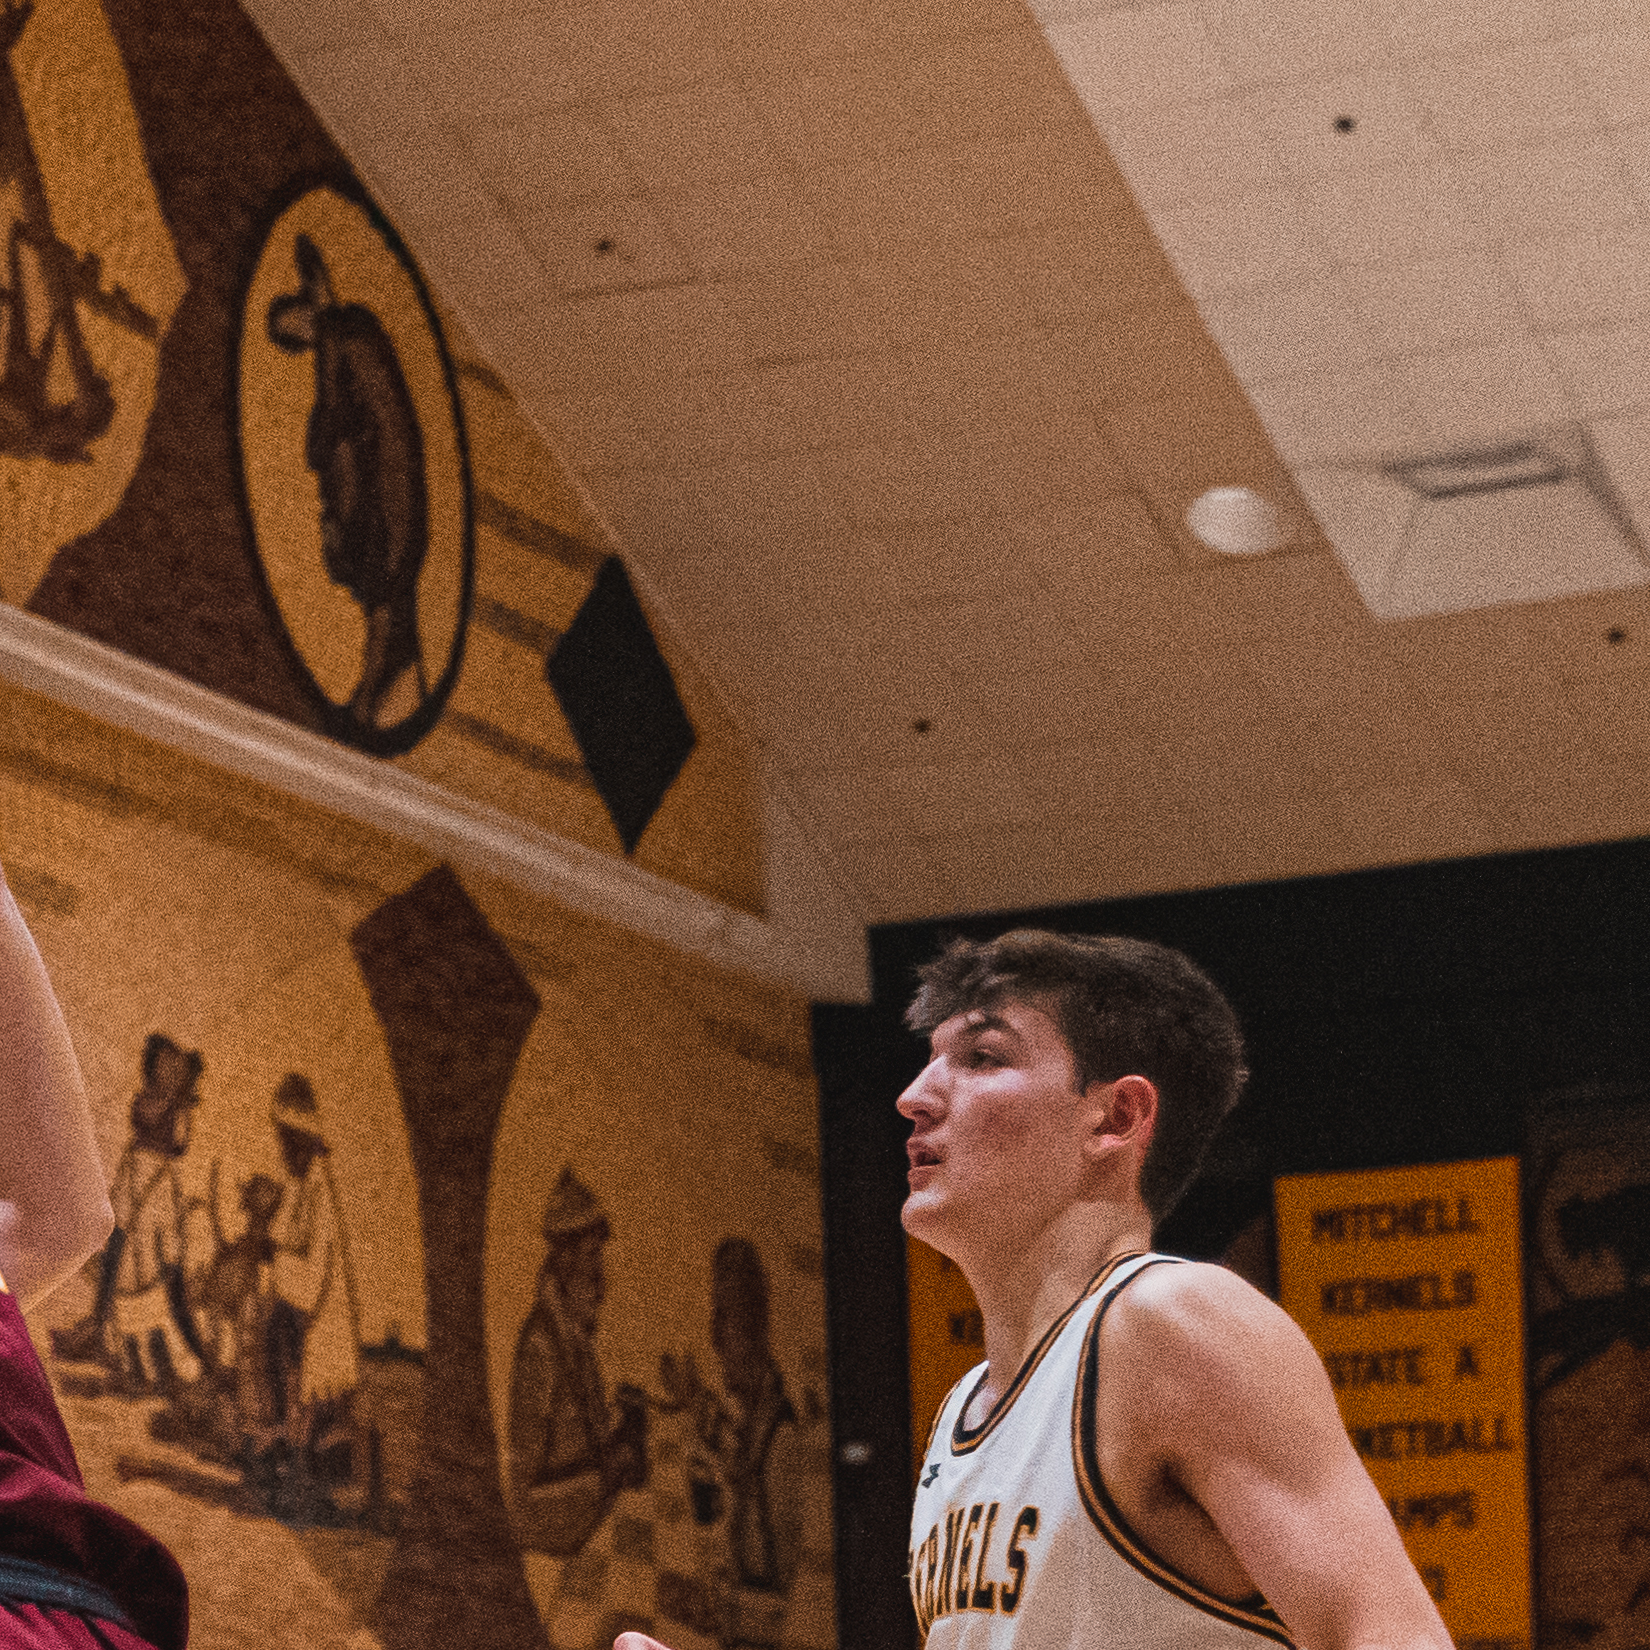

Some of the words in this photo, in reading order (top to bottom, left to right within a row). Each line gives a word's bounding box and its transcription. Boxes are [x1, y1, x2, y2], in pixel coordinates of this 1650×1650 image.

[1311, 1197, 1484, 1245] MITCHELL
[1320, 1269, 1477, 1317] KERNELS
[1324, 1348, 1426, 1390] STATE
[1454, 1345, 1482, 1380] A
